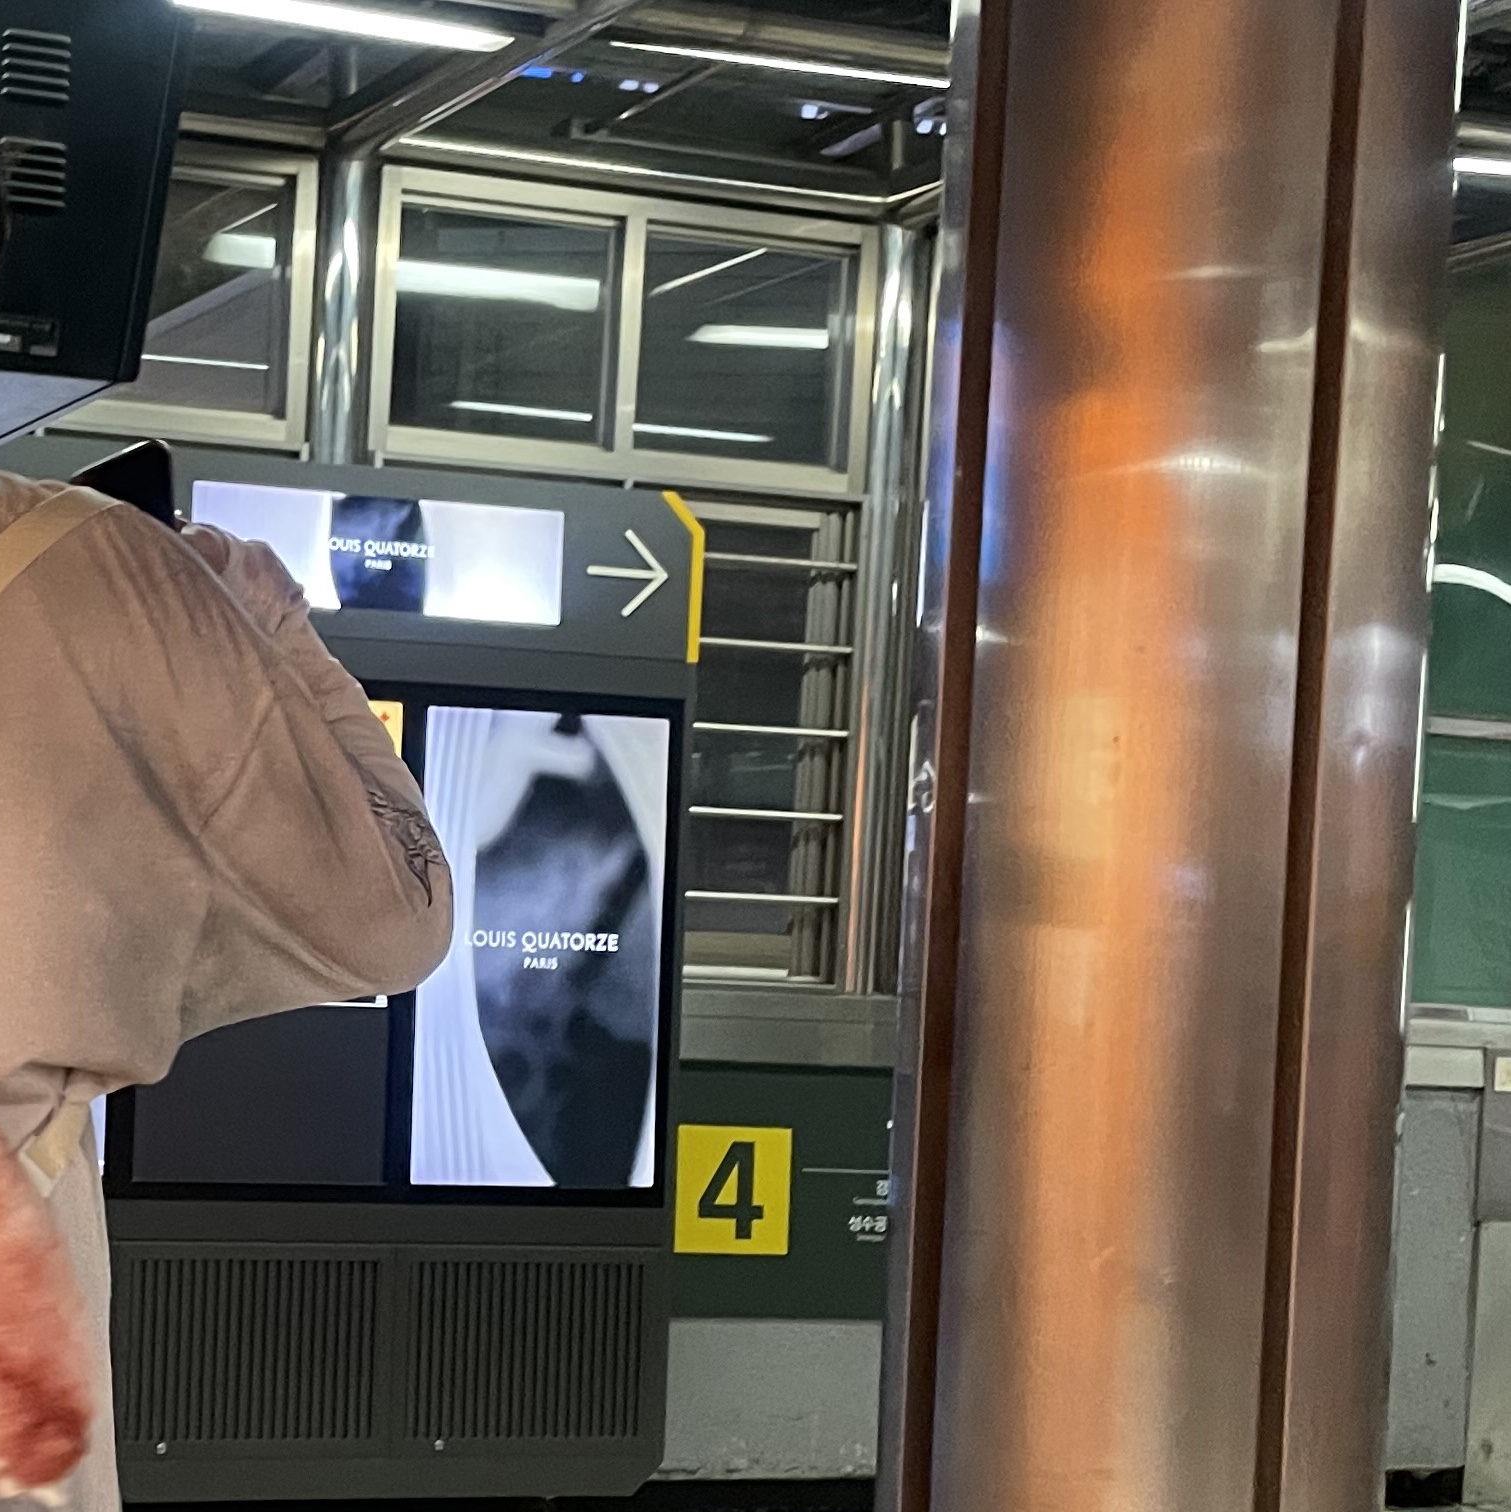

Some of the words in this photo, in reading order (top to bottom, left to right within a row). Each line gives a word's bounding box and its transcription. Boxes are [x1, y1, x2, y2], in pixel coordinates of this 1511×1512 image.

[329, 538, 361, 552] OUIS
[465, 930, 516, 948] LOUIS
[521, 931, 619, 953] QUATORZE
[523, 957, 558, 970] PARIS
[699, 1142, 763, 1239] 4
